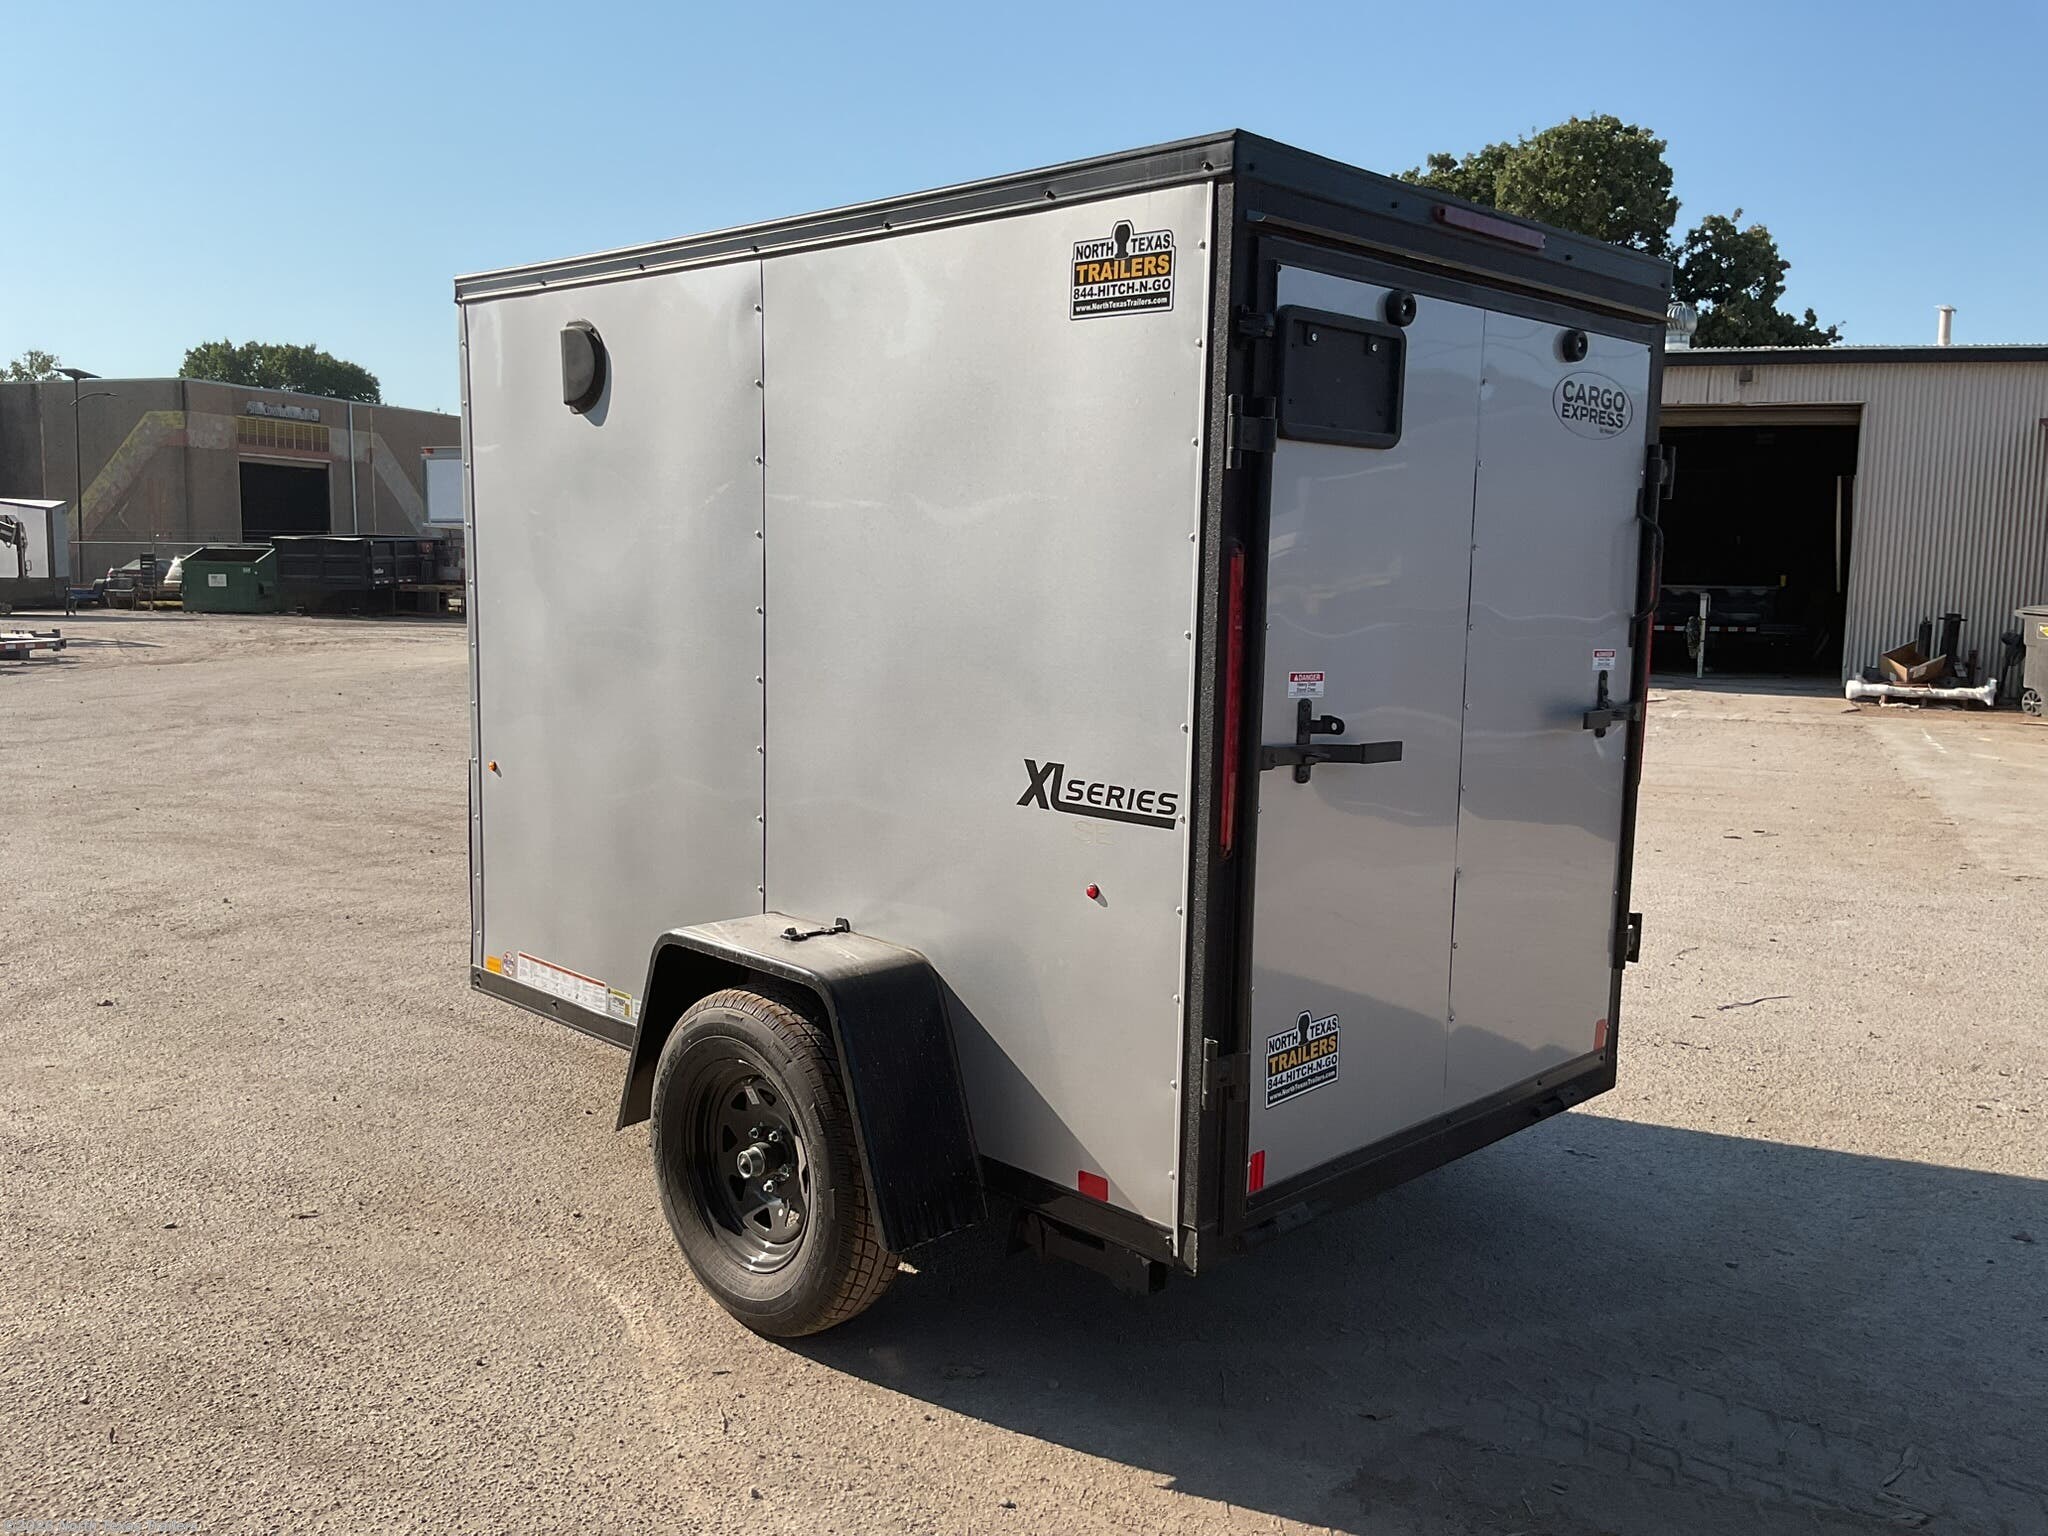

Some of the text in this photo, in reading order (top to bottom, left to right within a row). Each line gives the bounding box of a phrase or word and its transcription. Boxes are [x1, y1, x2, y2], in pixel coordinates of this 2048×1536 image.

[1076, 234, 1171, 260] NORTH TEXAS
[1076, 254, 1170, 284] TRAILERS
[1073, 278, 1171, 300] 844-HITCH-N-GO
[1075, 297, 1168, 312] www.NorthTexasTrailers.com
[1562, 380, 1626, 412] CARGO
[1561, 402, 1624, 428] EXPRESS
[1065, 779, 1179, 816] SERIES
[1269, 1018, 1337, 1053] NORTH TEXAS
[1269, 1035, 1337, 1074] TRAILERS
